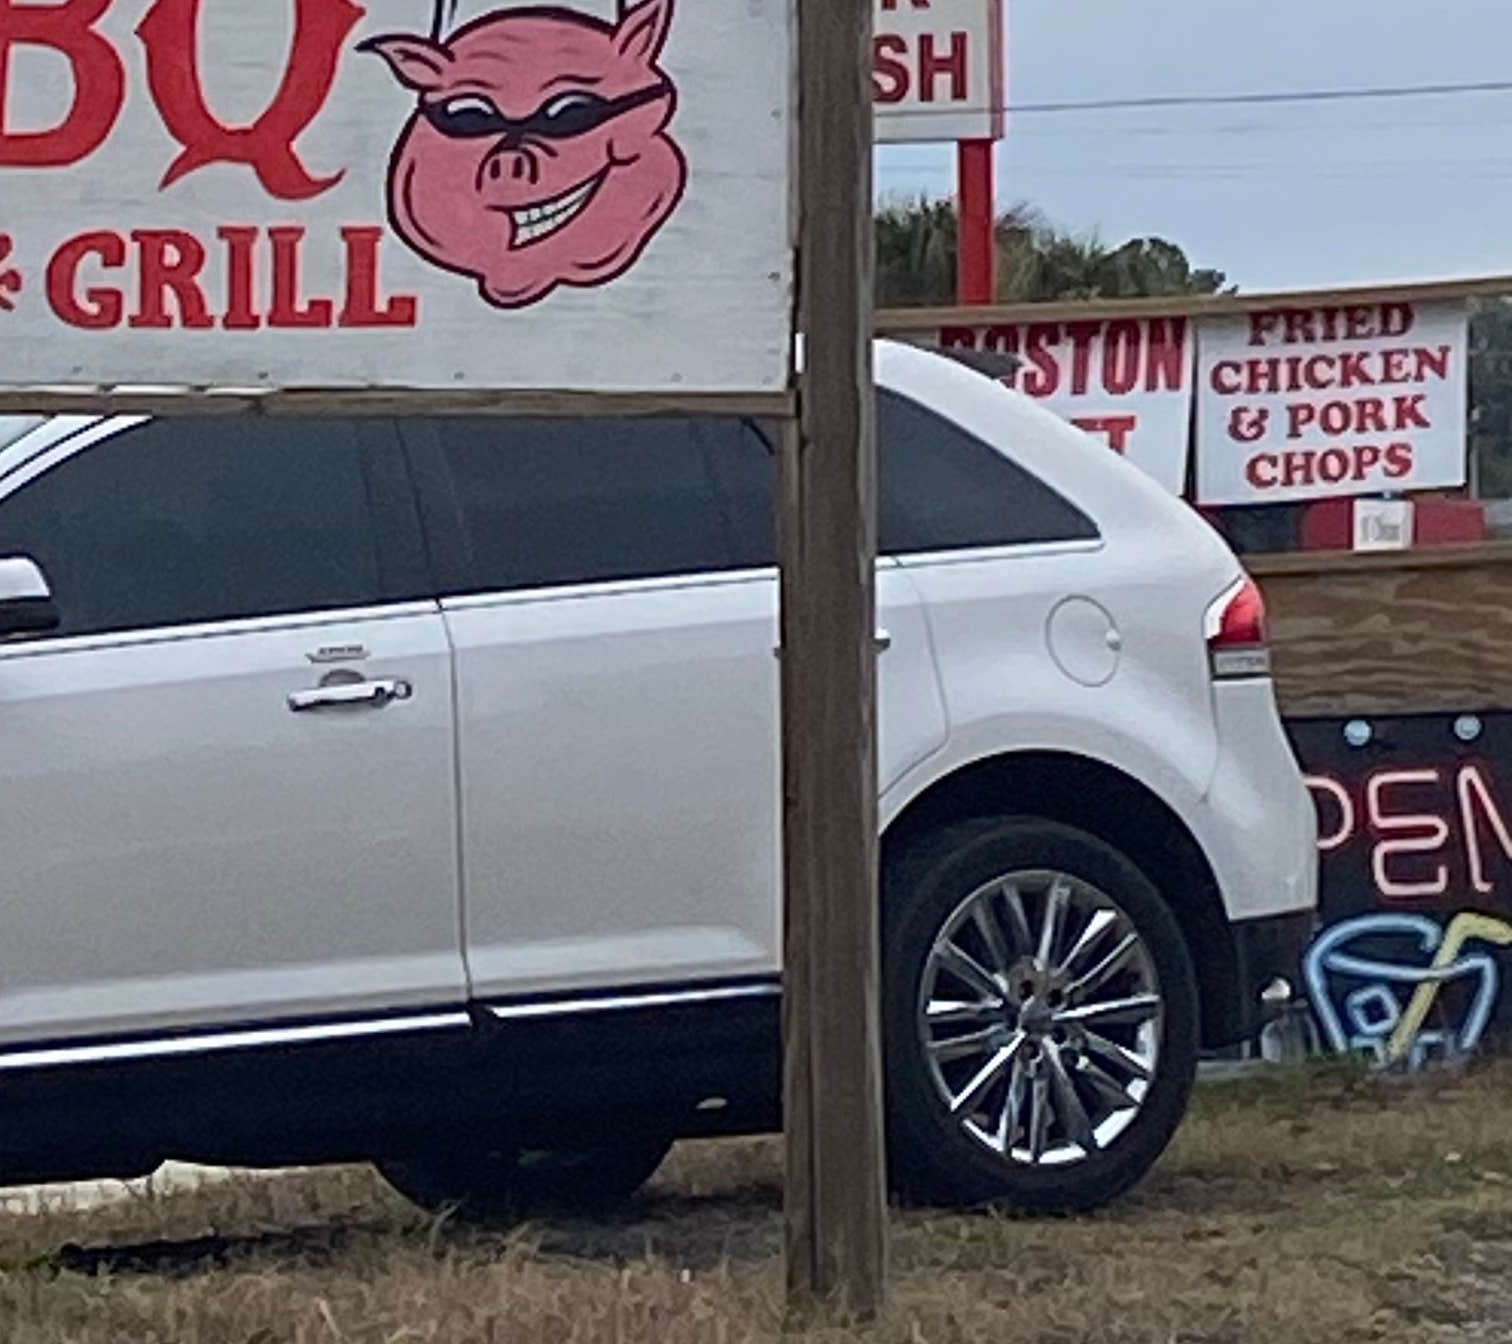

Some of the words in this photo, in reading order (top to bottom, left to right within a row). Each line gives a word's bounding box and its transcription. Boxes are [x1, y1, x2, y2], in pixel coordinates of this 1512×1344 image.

[45, 226, 418, 330] GRILL
[1247, 301, 1416, 348] FRIED
[1209, 346, 1451, 396] CHICKEN
[1227, 406, 1270, 443] &
[1285, 394, 1431, 439] PORK
[1245, 443, 1414, 490] CHOPS
